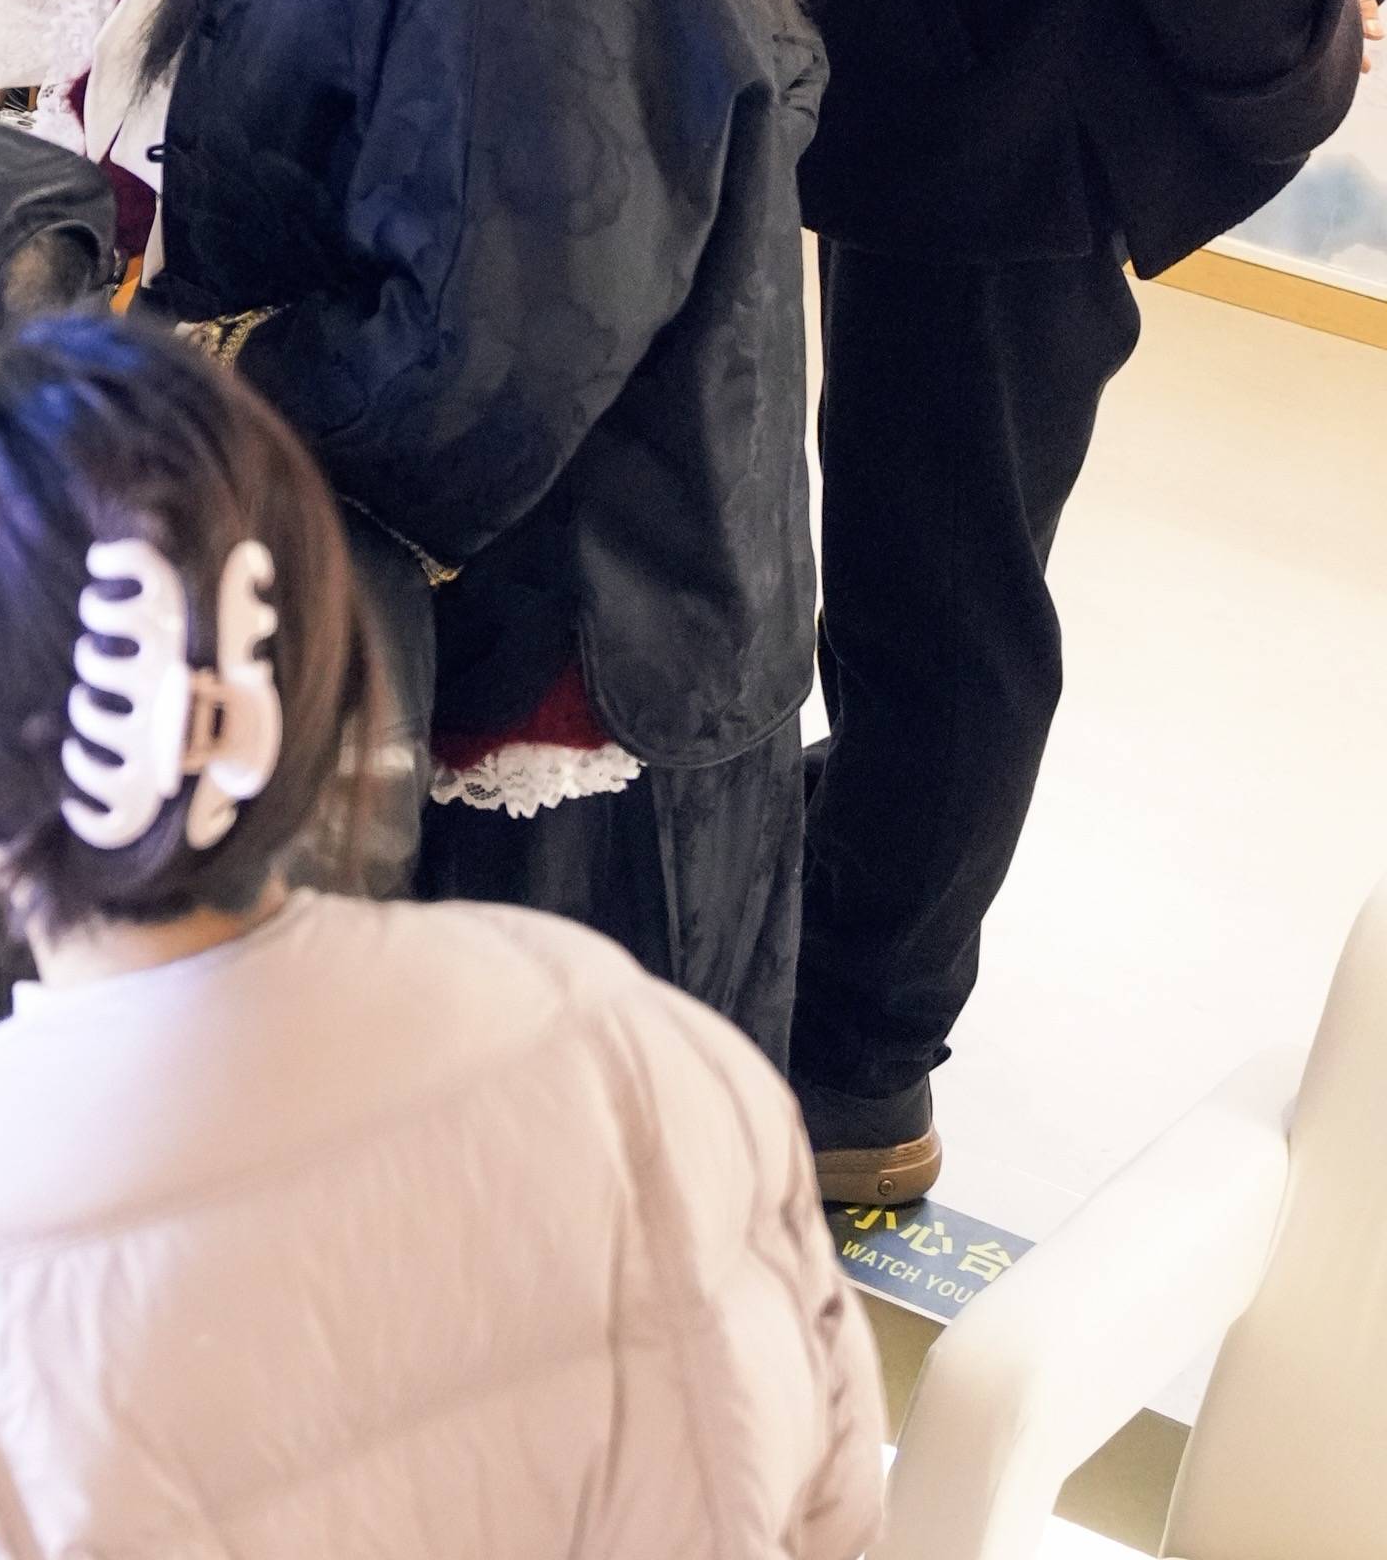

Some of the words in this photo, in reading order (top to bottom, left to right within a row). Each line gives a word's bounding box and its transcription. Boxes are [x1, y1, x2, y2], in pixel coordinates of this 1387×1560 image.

[841, 1240, 923, 1284] WATCH
[844, 1208, 1013, 1283] 小心台
